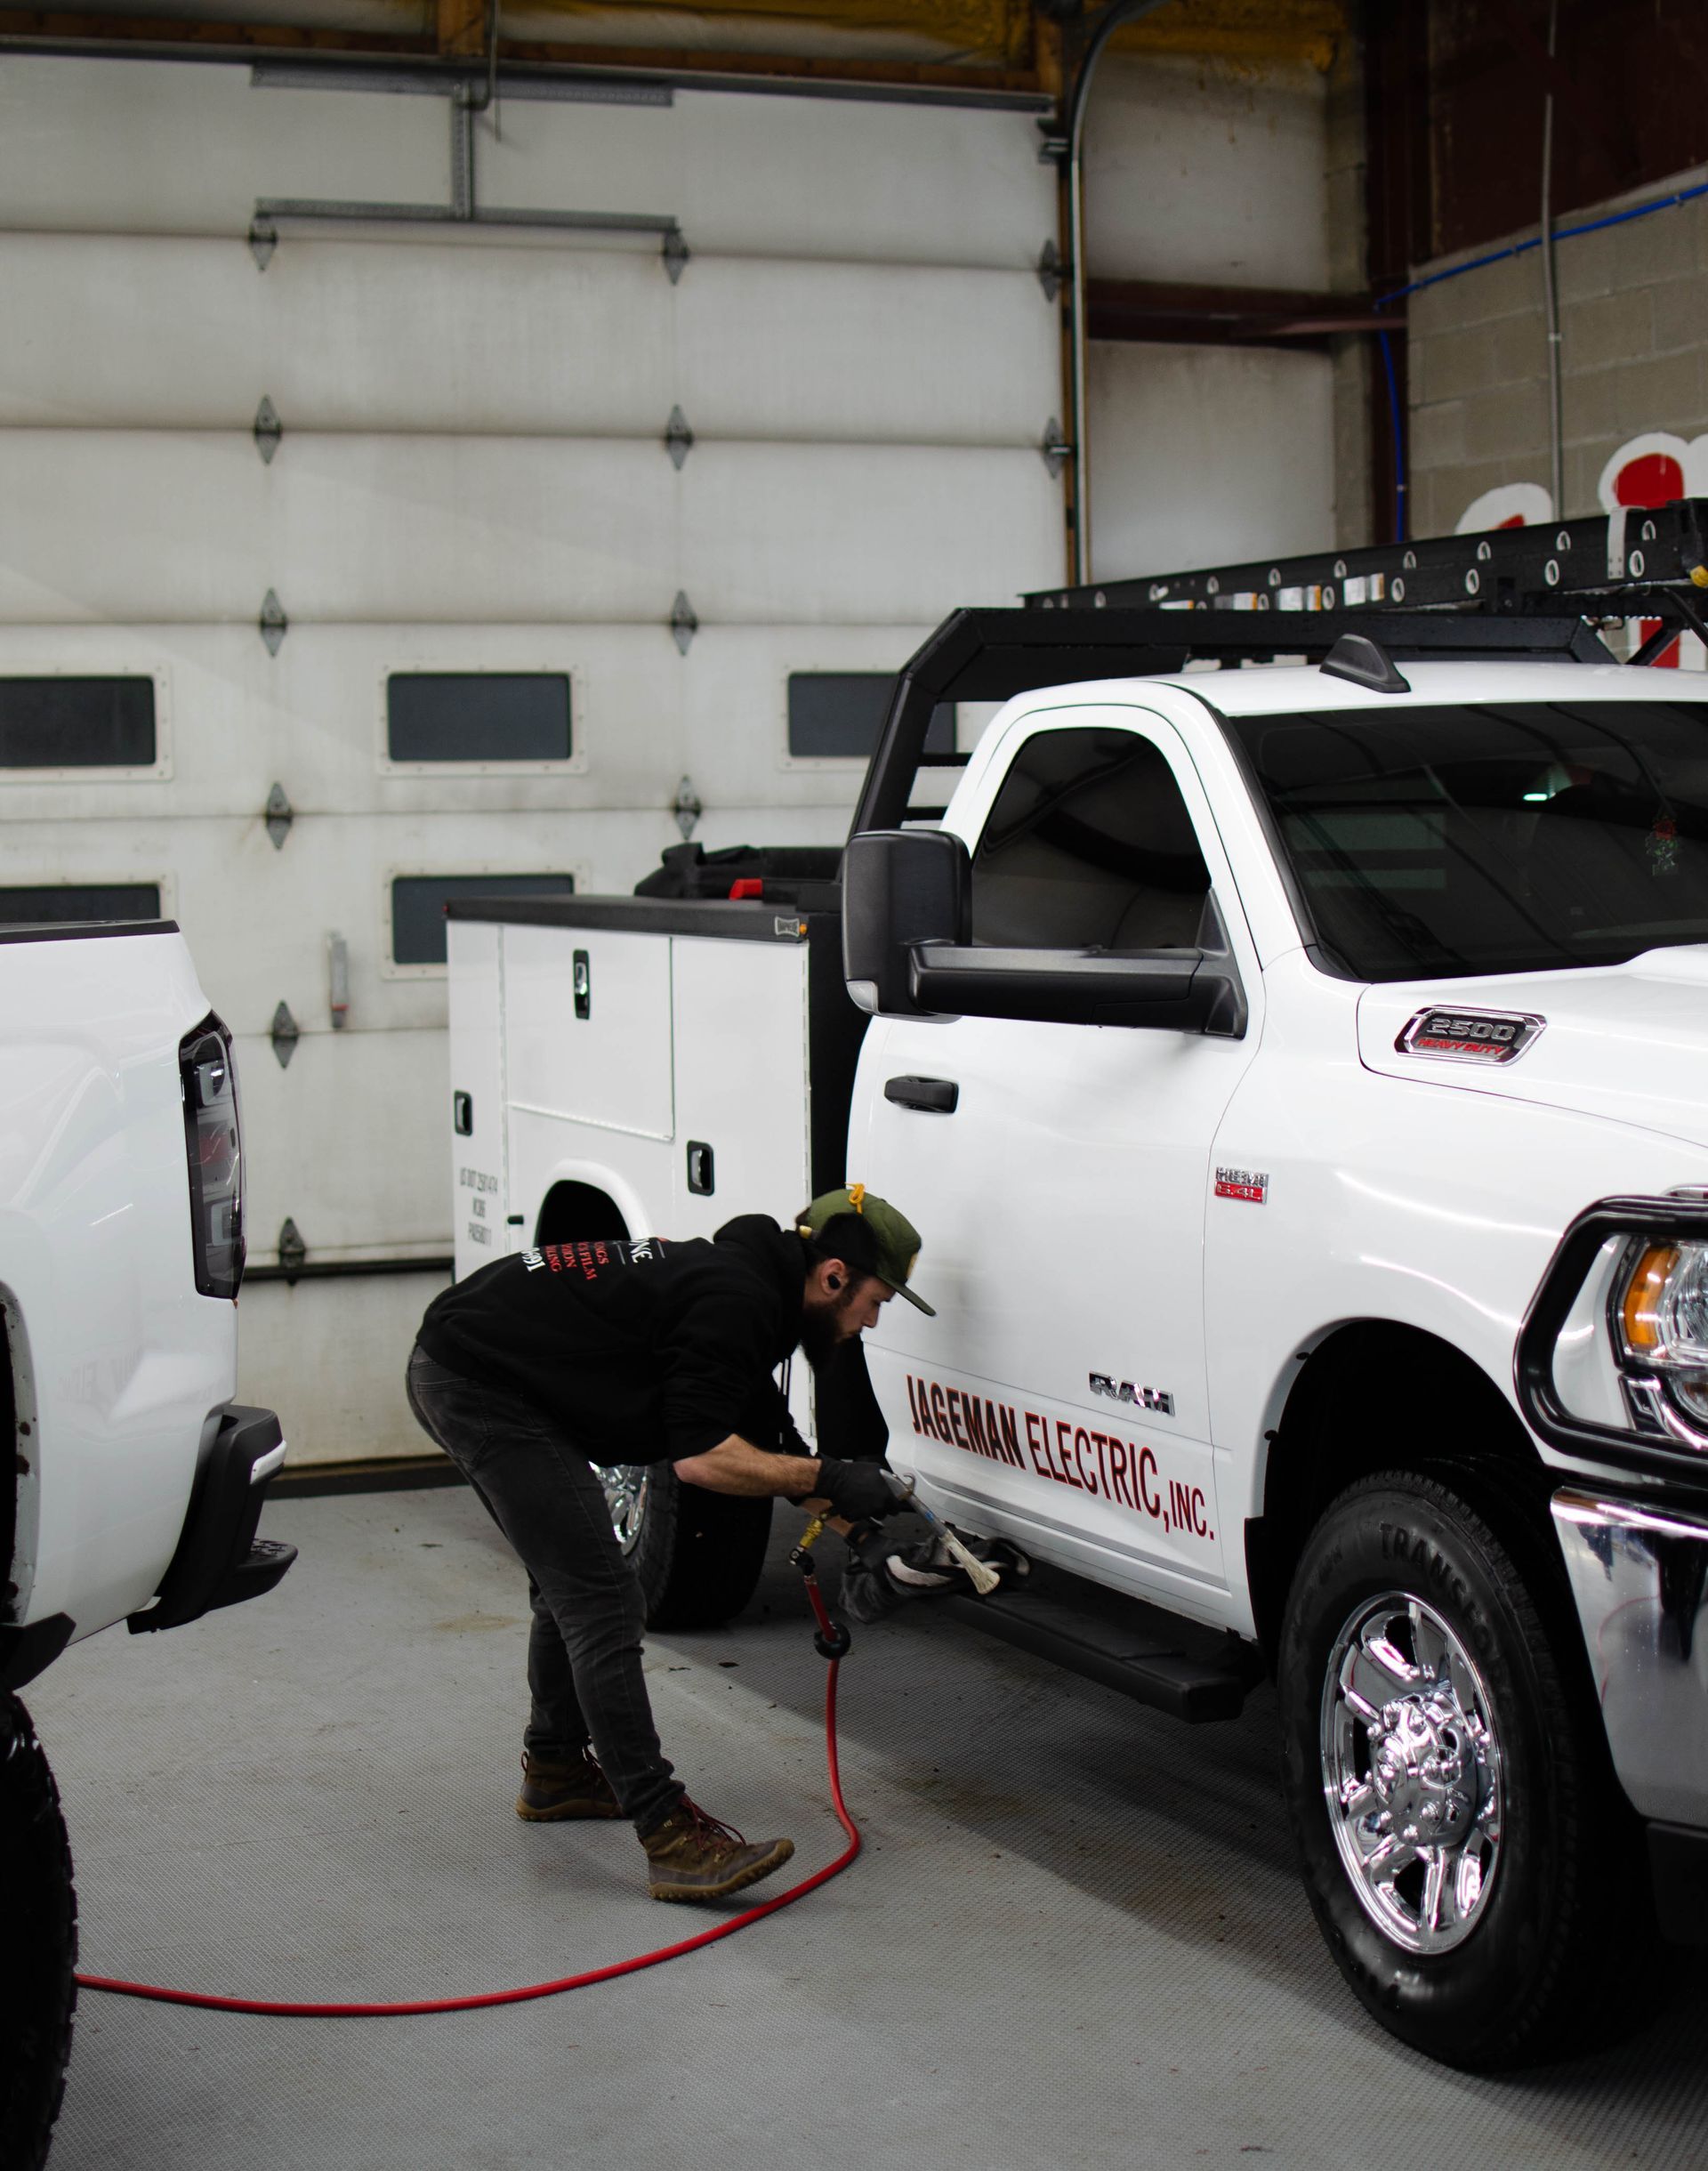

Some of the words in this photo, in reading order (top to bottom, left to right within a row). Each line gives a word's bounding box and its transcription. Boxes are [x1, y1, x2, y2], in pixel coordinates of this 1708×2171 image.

[1417, 1037, 1463, 1052] HEAVY
[1463, 1042, 1505, 1055] DUTY
[1427, 1018, 1516, 1041] 2500
[1089, 1371, 1175, 1416] RAM
[906, 1374, 1026, 1471] JAGEMAN
[1025, 1411, 1169, 1534] ELECTRIC,
[1169, 1480, 1214, 1540] INC.
